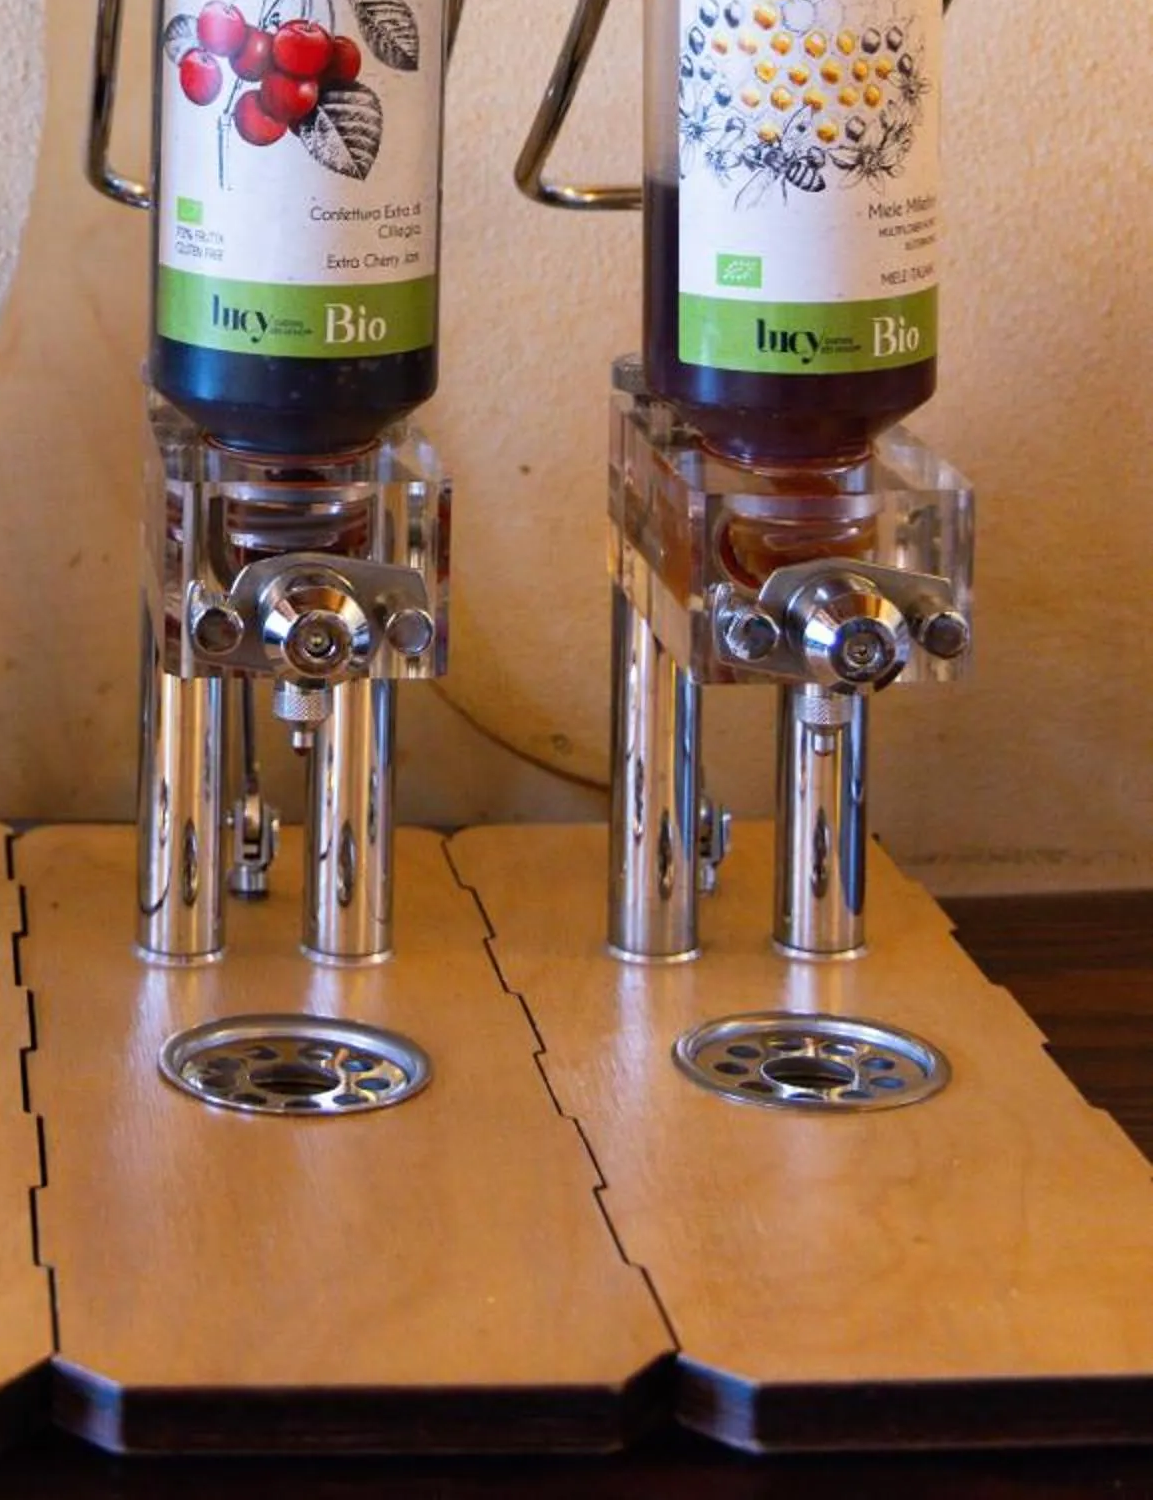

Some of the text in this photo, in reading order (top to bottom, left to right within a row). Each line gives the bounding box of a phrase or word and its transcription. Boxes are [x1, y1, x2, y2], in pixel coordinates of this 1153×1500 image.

[326, 253, 360, 269] Extra
[213, 294, 387, 344] lucy Bio
[757, 316, 920, 365] lucy Bio
